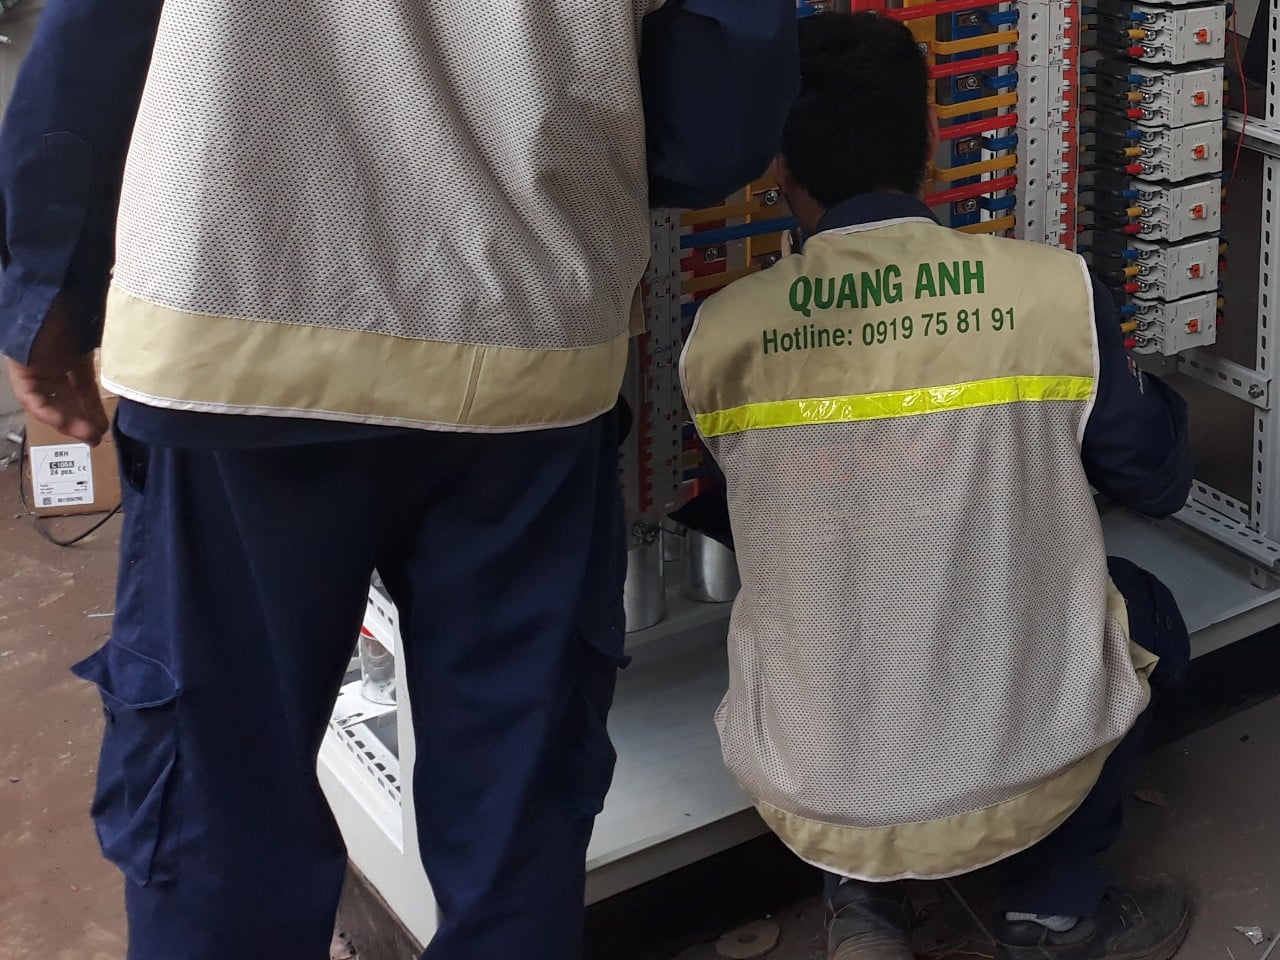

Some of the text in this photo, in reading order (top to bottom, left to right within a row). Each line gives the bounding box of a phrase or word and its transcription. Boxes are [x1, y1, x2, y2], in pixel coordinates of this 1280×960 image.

[789, 260, 985, 317] QUANG ANH
[762, 307, 1015, 354] Hotline: 0919 75 81 91
